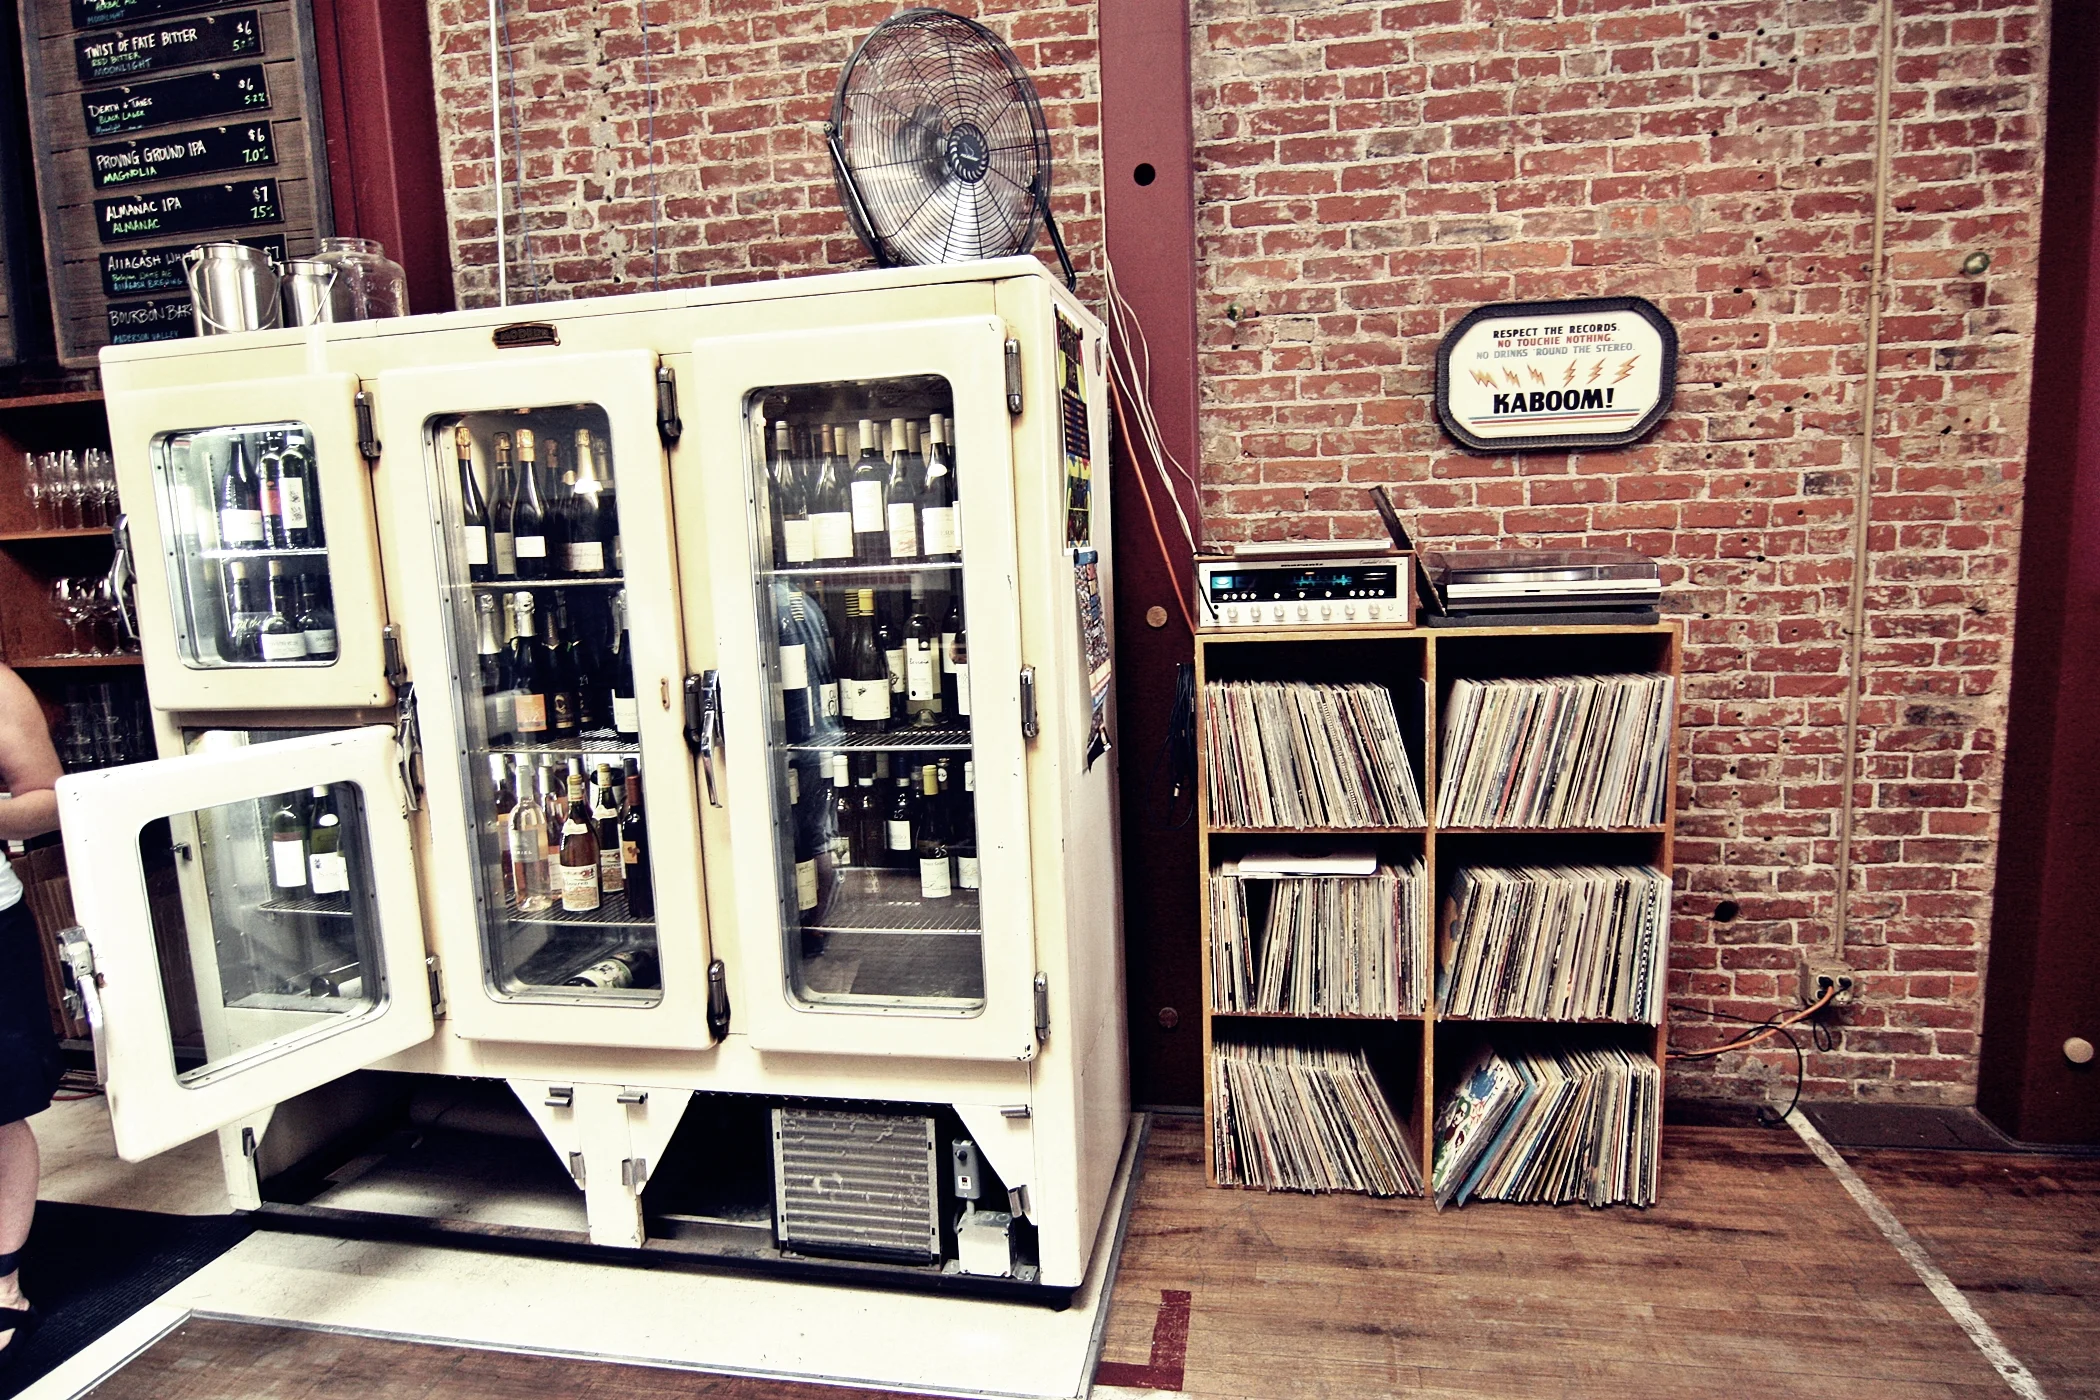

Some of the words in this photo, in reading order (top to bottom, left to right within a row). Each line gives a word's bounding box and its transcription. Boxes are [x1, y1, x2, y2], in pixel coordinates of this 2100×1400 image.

[236, 20, 252, 35] $6
[84, 42, 114, 59] TWIST
[118, 38, 130, 52] OF
[131, 33, 156, 50] FATE
[161, 28, 198, 46] BITTER
[91, 56, 109, 67] RED
[110, 52, 141, 64] BITTER
[94, 57, 153, 77] MOONLIGHT
[238, 78, 254, 91] $6
[87, 103, 120, 118] DEATH
[98, 114, 120, 124] BLACK
[122, 110, 146, 120] LAGER
[247, 128, 265, 142] $6
[96, 151, 140, 171] PROVING
[143, 144, 185, 163] GROUND
[188, 140, 207, 157] IPA
[103, 166, 158, 184] MAGNOLIA
[252, 186, 268, 202] $7
[106, 201, 158, 221] ALMANAC
[162, 197, 182, 212] IPA
[112, 218, 161, 234] ALMANAC
[108, 306, 165, 327] BOURBON
[151, 330, 179, 341] VALLEY
[1493, 327, 1538, 339] RESPECT
[1543, 325, 1564, 336] THE
[1569, 322, 1620, 334] RECORDS.
[1497, 339, 1512, 349] NO
[1516, 336, 1561, 347] TOUCHIE
[1566, 333, 1615, 344] NOTHING.
[1476, 350, 1489, 360] NO
[1493, 348, 1529, 359] DRINKS
[1573, 344, 1591, 354] THE
[1595, 342, 1635, 353] STEREO.
[1493, 387, 1614, 414] KABOOM!
